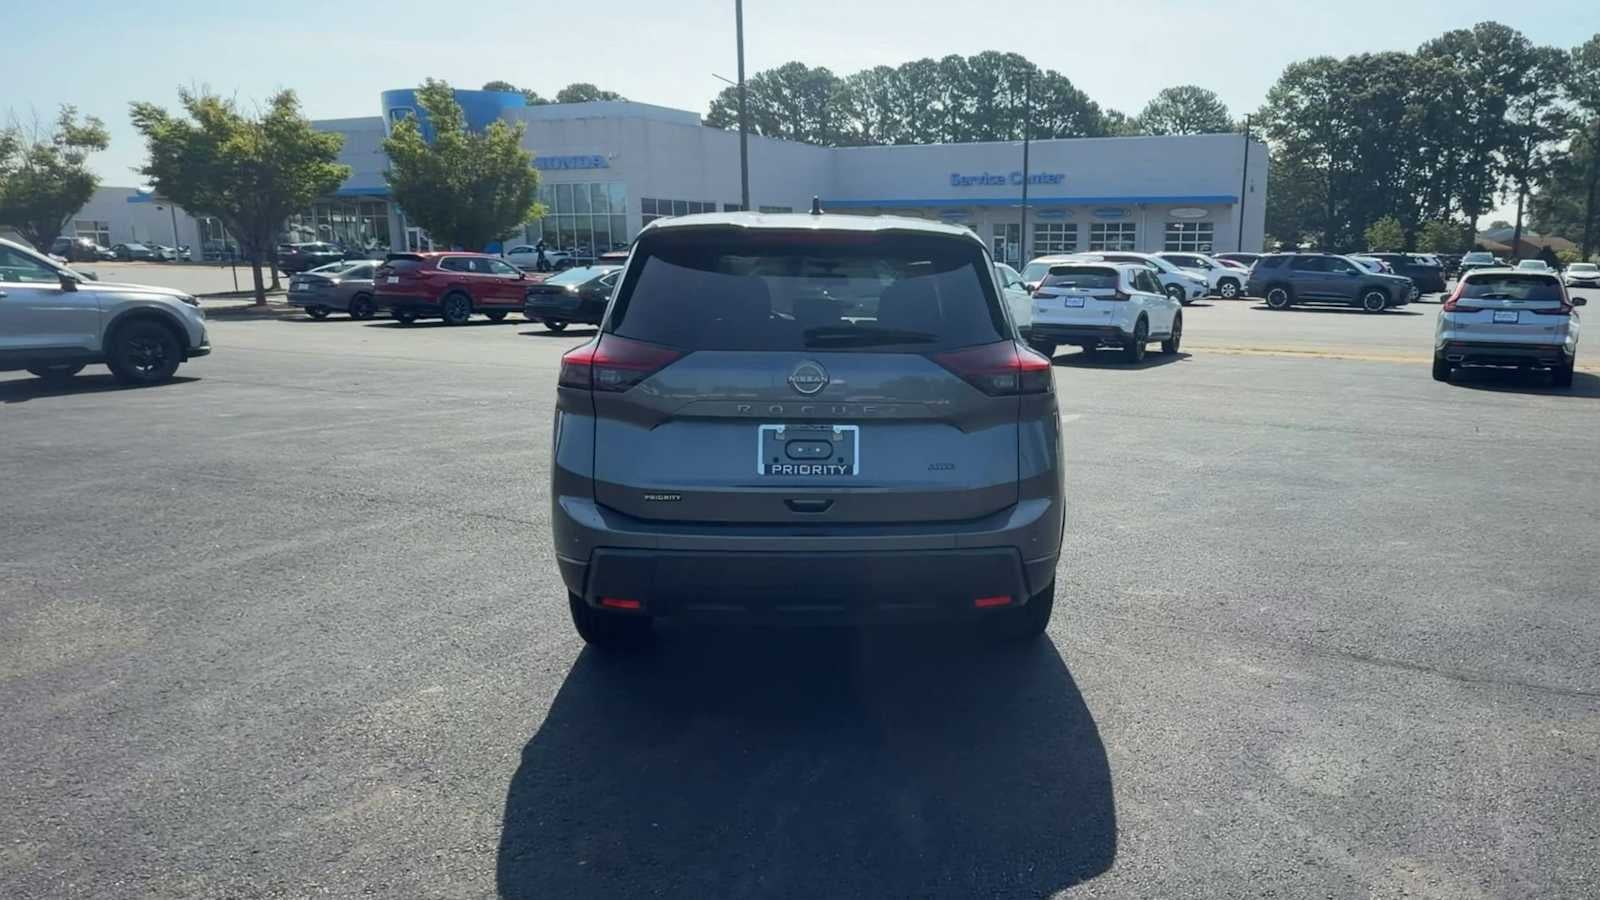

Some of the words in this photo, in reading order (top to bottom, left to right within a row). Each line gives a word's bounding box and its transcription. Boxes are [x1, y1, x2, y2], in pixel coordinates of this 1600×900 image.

[951, 172, 1005, 186] Service
[788, 376, 828, 384] NISSAN
[737, 404, 876, 415] ROGUE
[771, 465, 847, 474] PRIORITY
